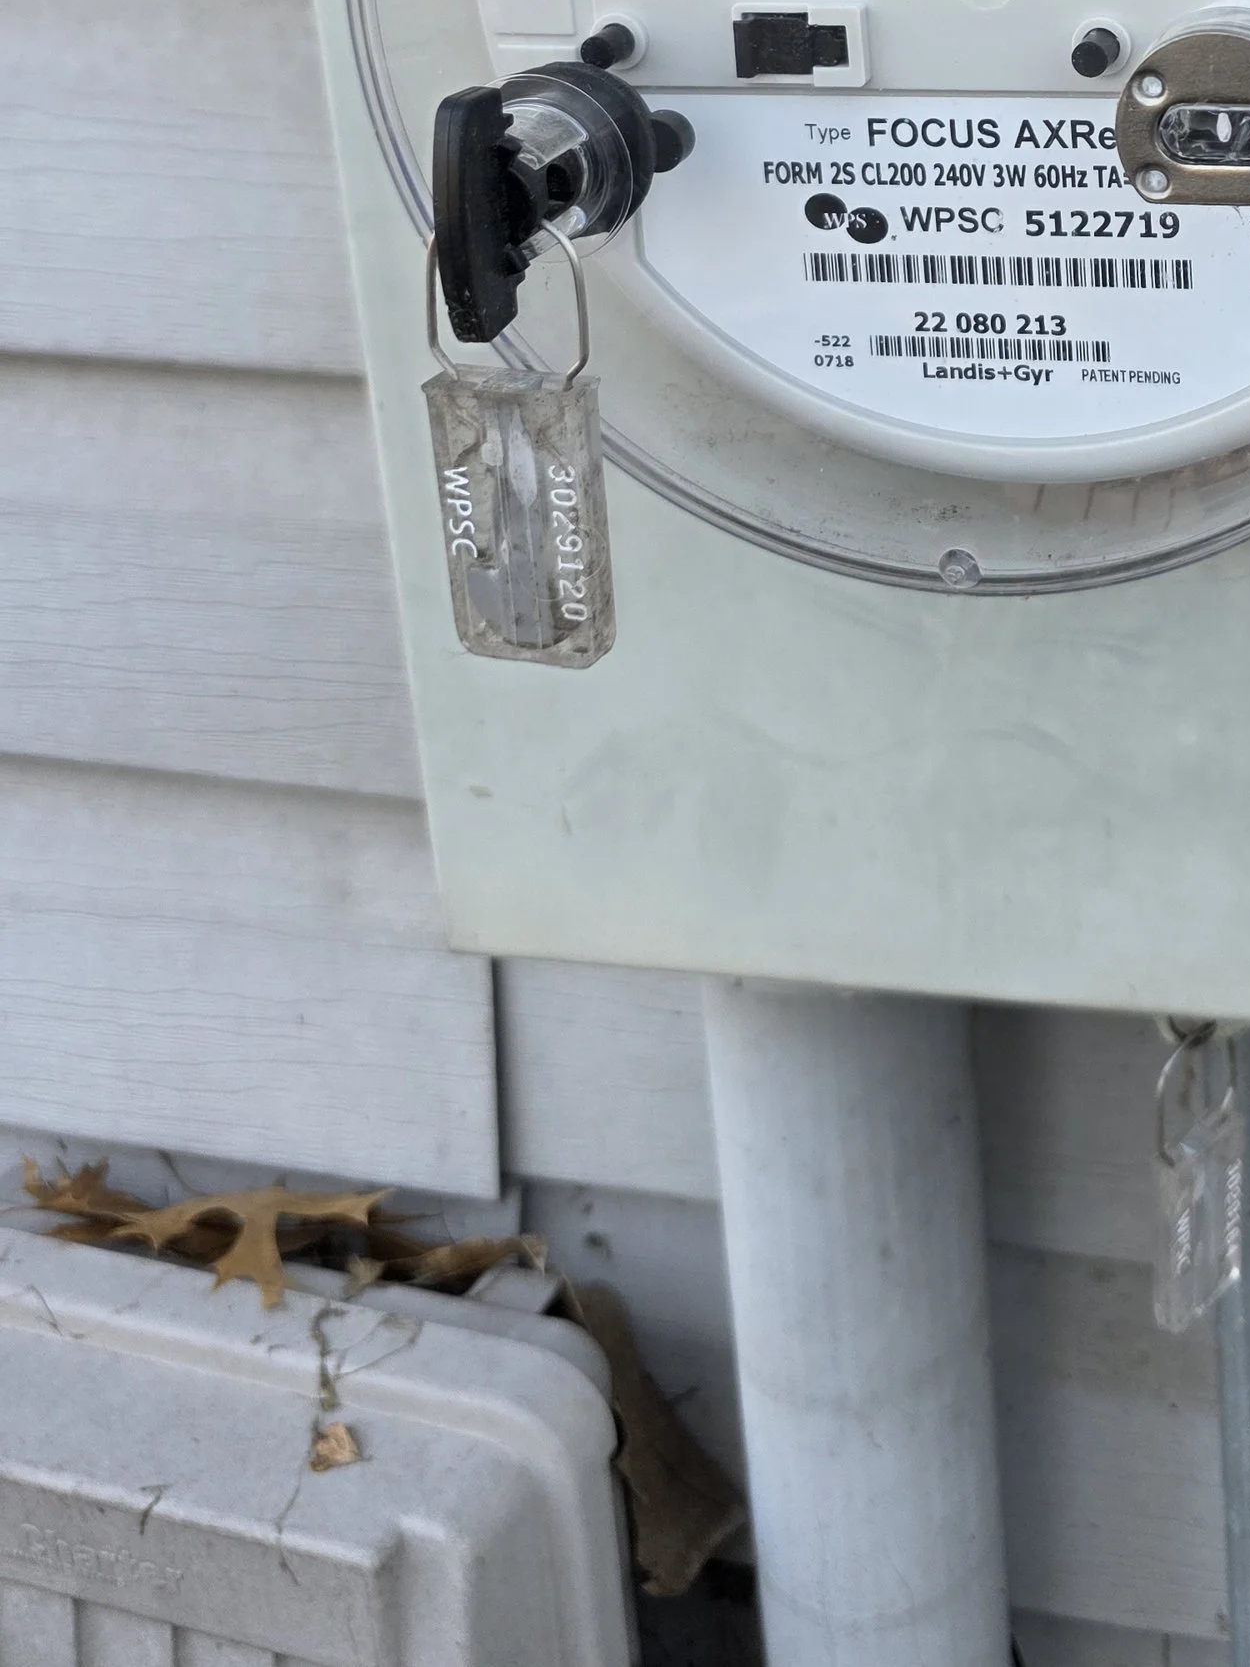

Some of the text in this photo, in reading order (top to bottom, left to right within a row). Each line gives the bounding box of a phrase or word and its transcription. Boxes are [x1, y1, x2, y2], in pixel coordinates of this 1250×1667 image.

[804, 123, 852, 145] Type
[867, 117, 1001, 149] FOCUS
[763, 161, 824, 185] FORM
[830, 161, 856, 186] 2S
[861, 162, 927, 187] CL200
[933, 162, 986, 187] 240V
[992, 163, 1027, 188] 3W
[1033, 164, 1089, 189] 60Hz
[822, 204, 1181, 239] WPS WPSC 5122719
[914, 311, 1067, 336] 22 080 213
[814, 335, 852, 348] -522
[814, 355, 855, 368] 0718
[922, 361, 1181, 386] Landis+Gyr PATENT PENDING
[443, 465, 478, 559] WPSC
[548, 464, 590, 622] 3029120
